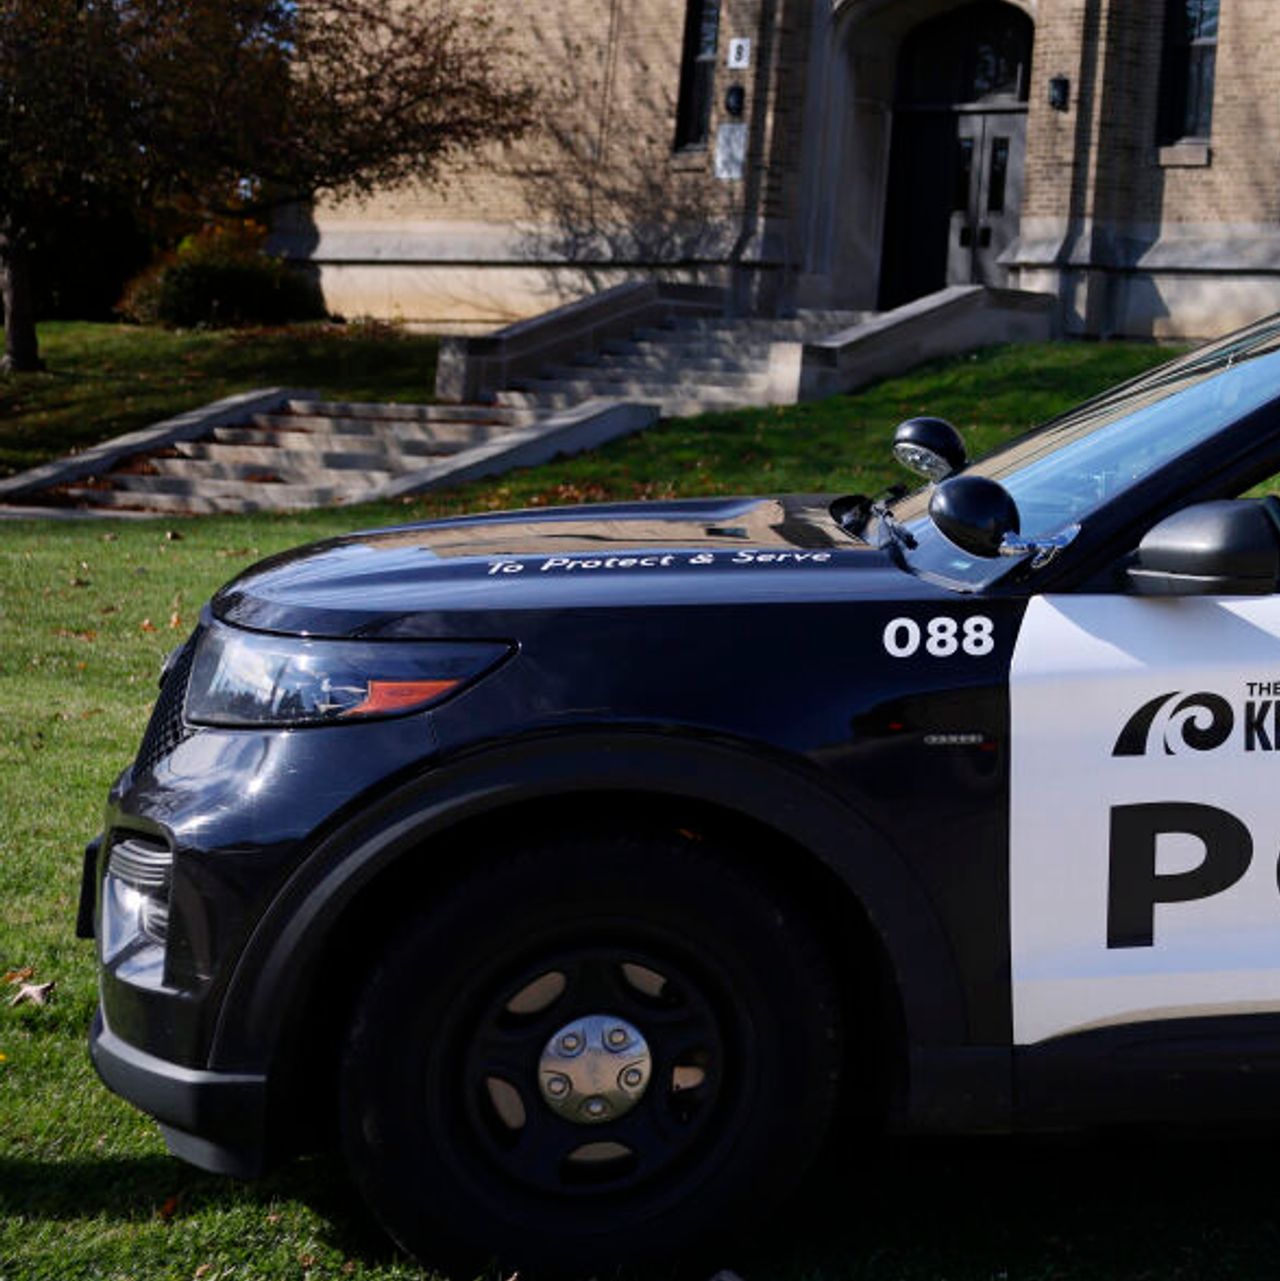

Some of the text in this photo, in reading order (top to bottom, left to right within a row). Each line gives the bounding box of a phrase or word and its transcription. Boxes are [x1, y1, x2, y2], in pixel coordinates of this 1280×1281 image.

[488, 548, 831, 575] To Protect & Serve
[883, 615, 995, 658] 088
